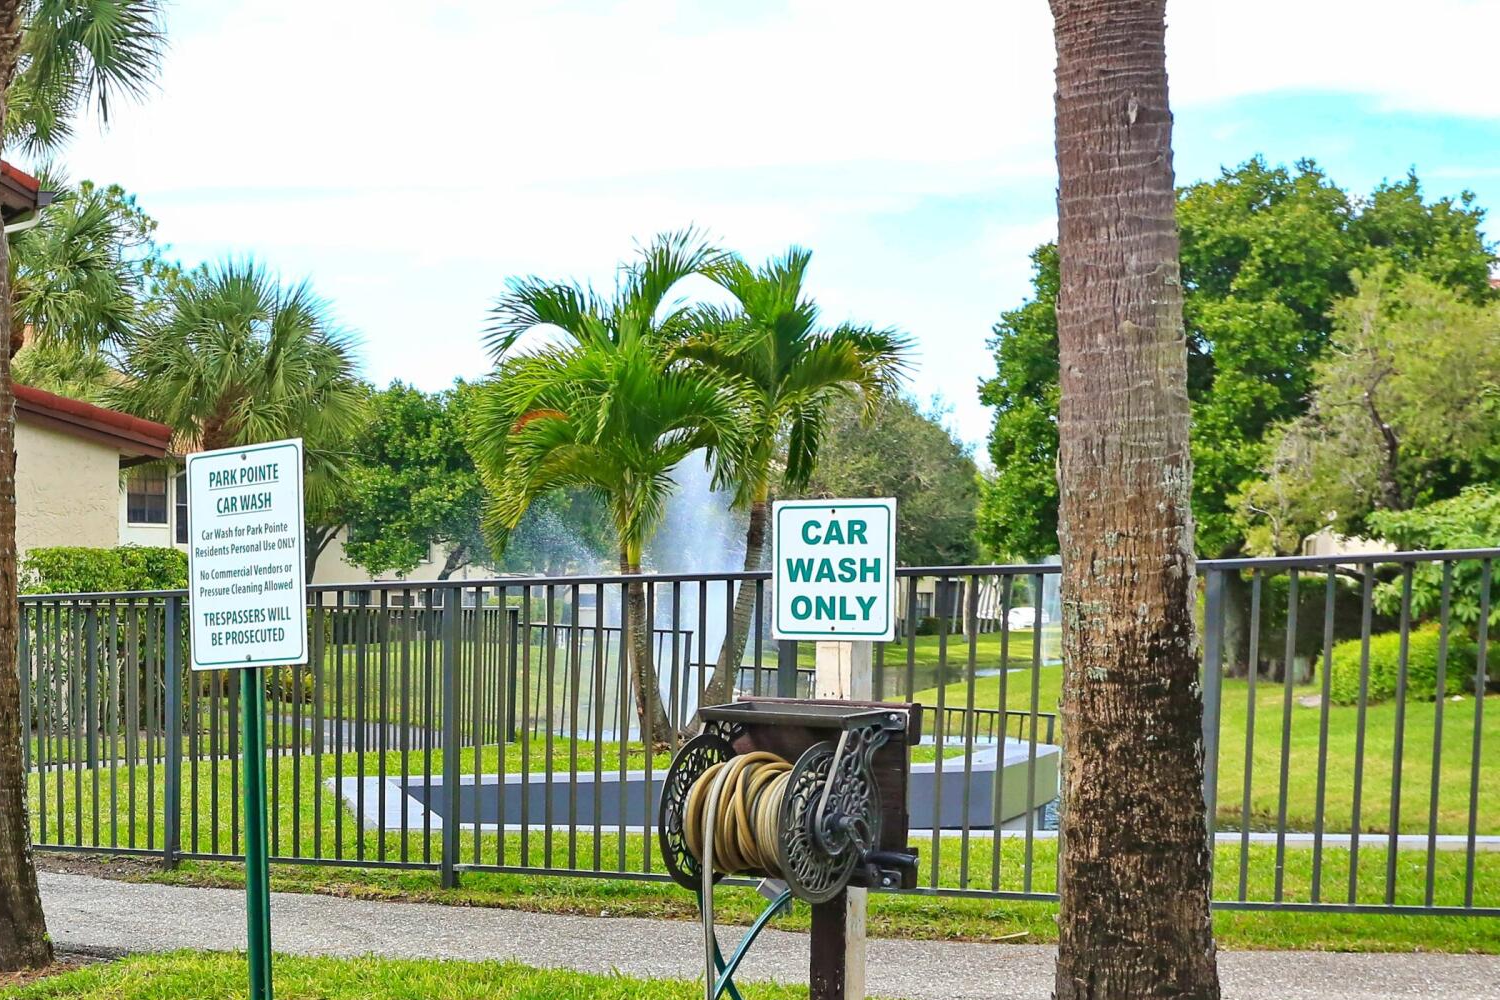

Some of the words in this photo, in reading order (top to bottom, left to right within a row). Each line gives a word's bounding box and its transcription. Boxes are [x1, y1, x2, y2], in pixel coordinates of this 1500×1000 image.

[209, 468, 237, 488] PARK
[240, 463, 279, 485] POINTE
[216, 496, 237, 513] CAR
[240, 492, 272, 511] WASH
[202, 529, 213, 540] Car
[214, 527, 233, 539] Wash
[235, 526, 245, 537] for
[247, 524, 262, 535] Park
[265, 522, 288, 534] Pointe
[802, 520, 867, 544] CAR
[196, 545, 229, 557] Residents
[231, 542, 261, 553] Personal
[263, 540, 275, 551] Use
[277, 537, 295, 549] ONLY
[200, 569, 209, 580] No
[211, 565, 252, 579] Commercial
[254, 564, 282, 576] Vendors
[284, 563, 292, 573] or
[787, 558, 880, 582] WASH
[200, 586, 230, 597] Pressure
[231, 582, 262, 595] Cleaning
[264, 579, 293, 591] Allowed
[204, 608, 265, 627] TRESPASSERS
[267, 607, 291, 621] WILL
[791, 595, 877, 620] ONLY
[211, 632, 223, 646] BE
[225, 628, 284, 644] PROSECUTED
